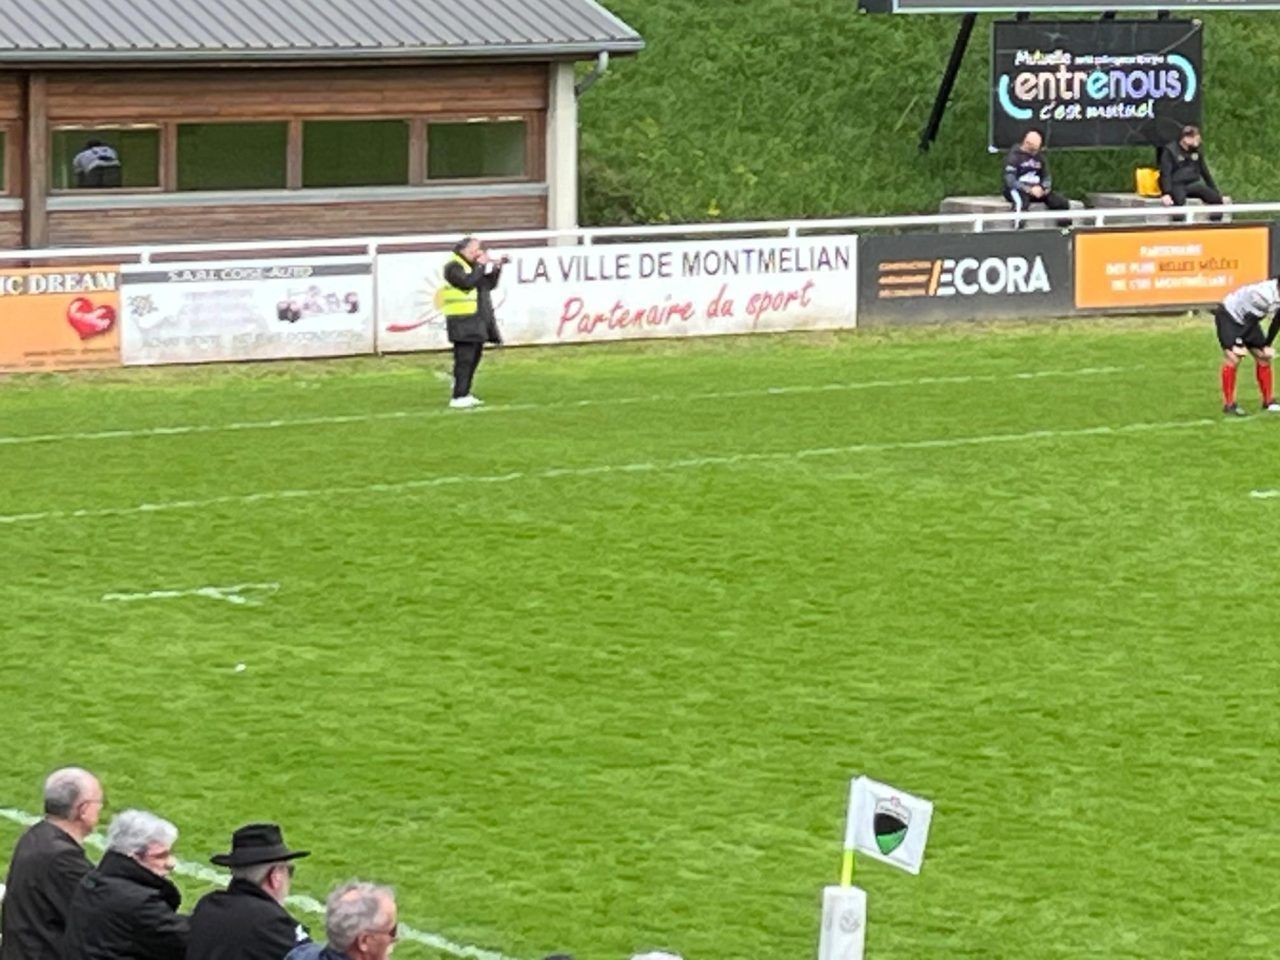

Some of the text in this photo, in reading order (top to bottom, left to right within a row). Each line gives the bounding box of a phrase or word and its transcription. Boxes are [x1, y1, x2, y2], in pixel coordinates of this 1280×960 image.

[1014, 65, 1182, 101] entrenous
[27, 271, 117, 295] DREAM
[517, 244, 851, 284] LA VILLE DE MONTMELIAN
[936, 254, 1052, 296] ECORA
[556, 293, 696, 338] Partenaire
[744, 278, 816, 330] sport
